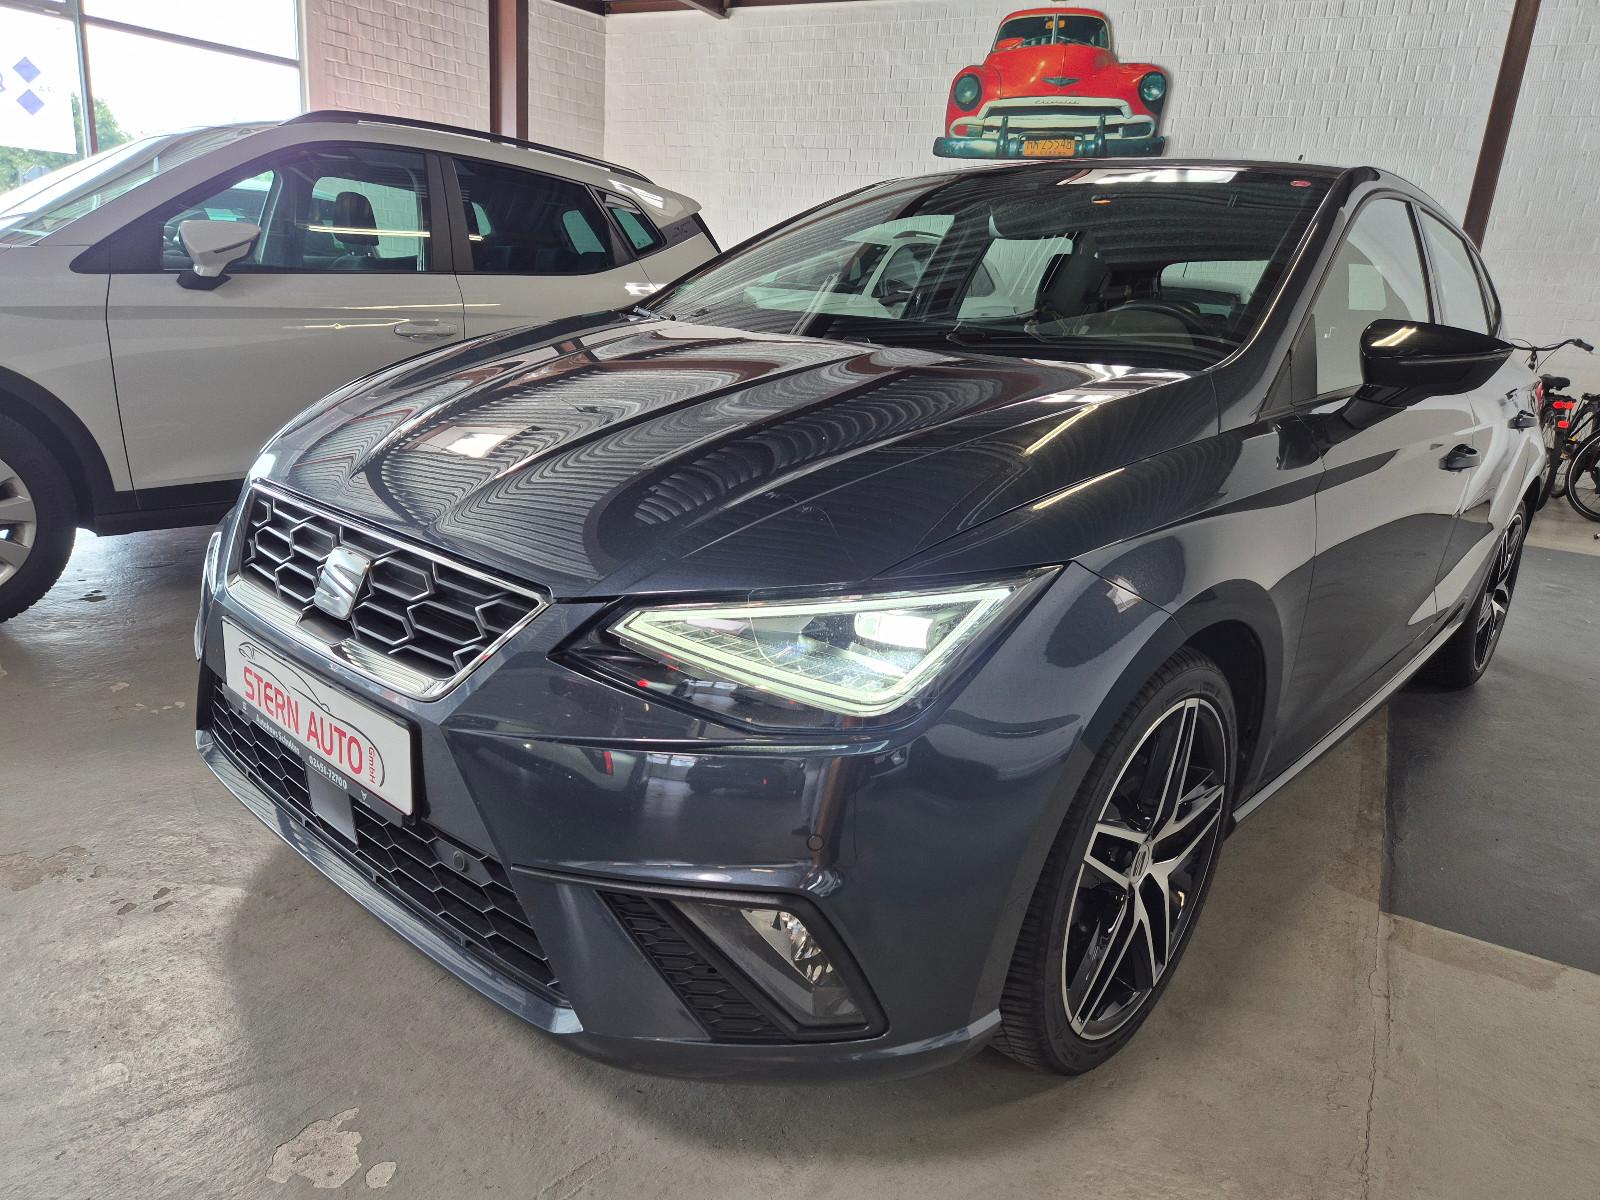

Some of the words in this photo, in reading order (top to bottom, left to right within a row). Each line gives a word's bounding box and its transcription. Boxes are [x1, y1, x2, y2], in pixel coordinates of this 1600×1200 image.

[243, 665, 300, 735] STERN
[306, 710, 363, 775] AUTO
[368, 746, 376, 784] GmbH
